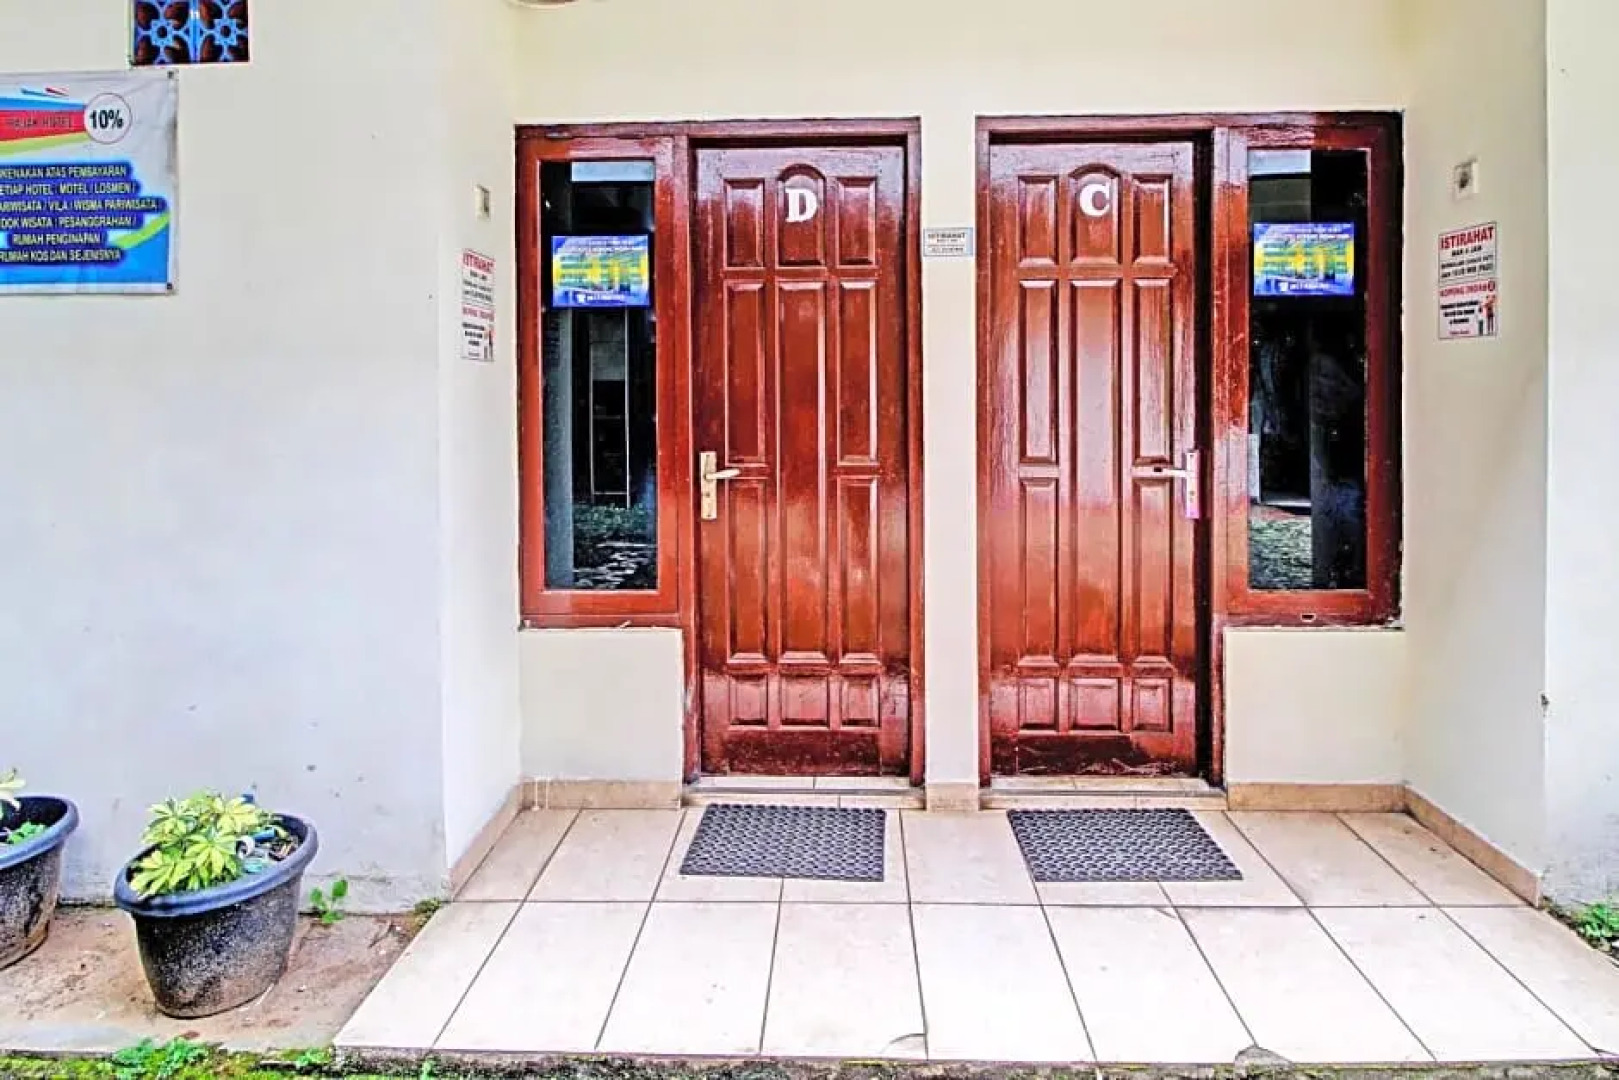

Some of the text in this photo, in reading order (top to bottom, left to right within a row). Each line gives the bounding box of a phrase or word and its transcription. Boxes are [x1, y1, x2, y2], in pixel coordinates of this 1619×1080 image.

[89, 109, 123, 129] 10%
[26, 183, 53, 195] HOTEL
[60, 182, 88, 194] MOTEL
[94, 182, 130, 194] LOSMEN
[785, 188, 817, 222] D
[1079, 182, 1109, 216] C
[21, 216, 52, 228] WISATA
[13, 232, 100, 245] RUMAH PENGINAPAN
[1441, 226, 1494, 249] ISTIRAHAT
